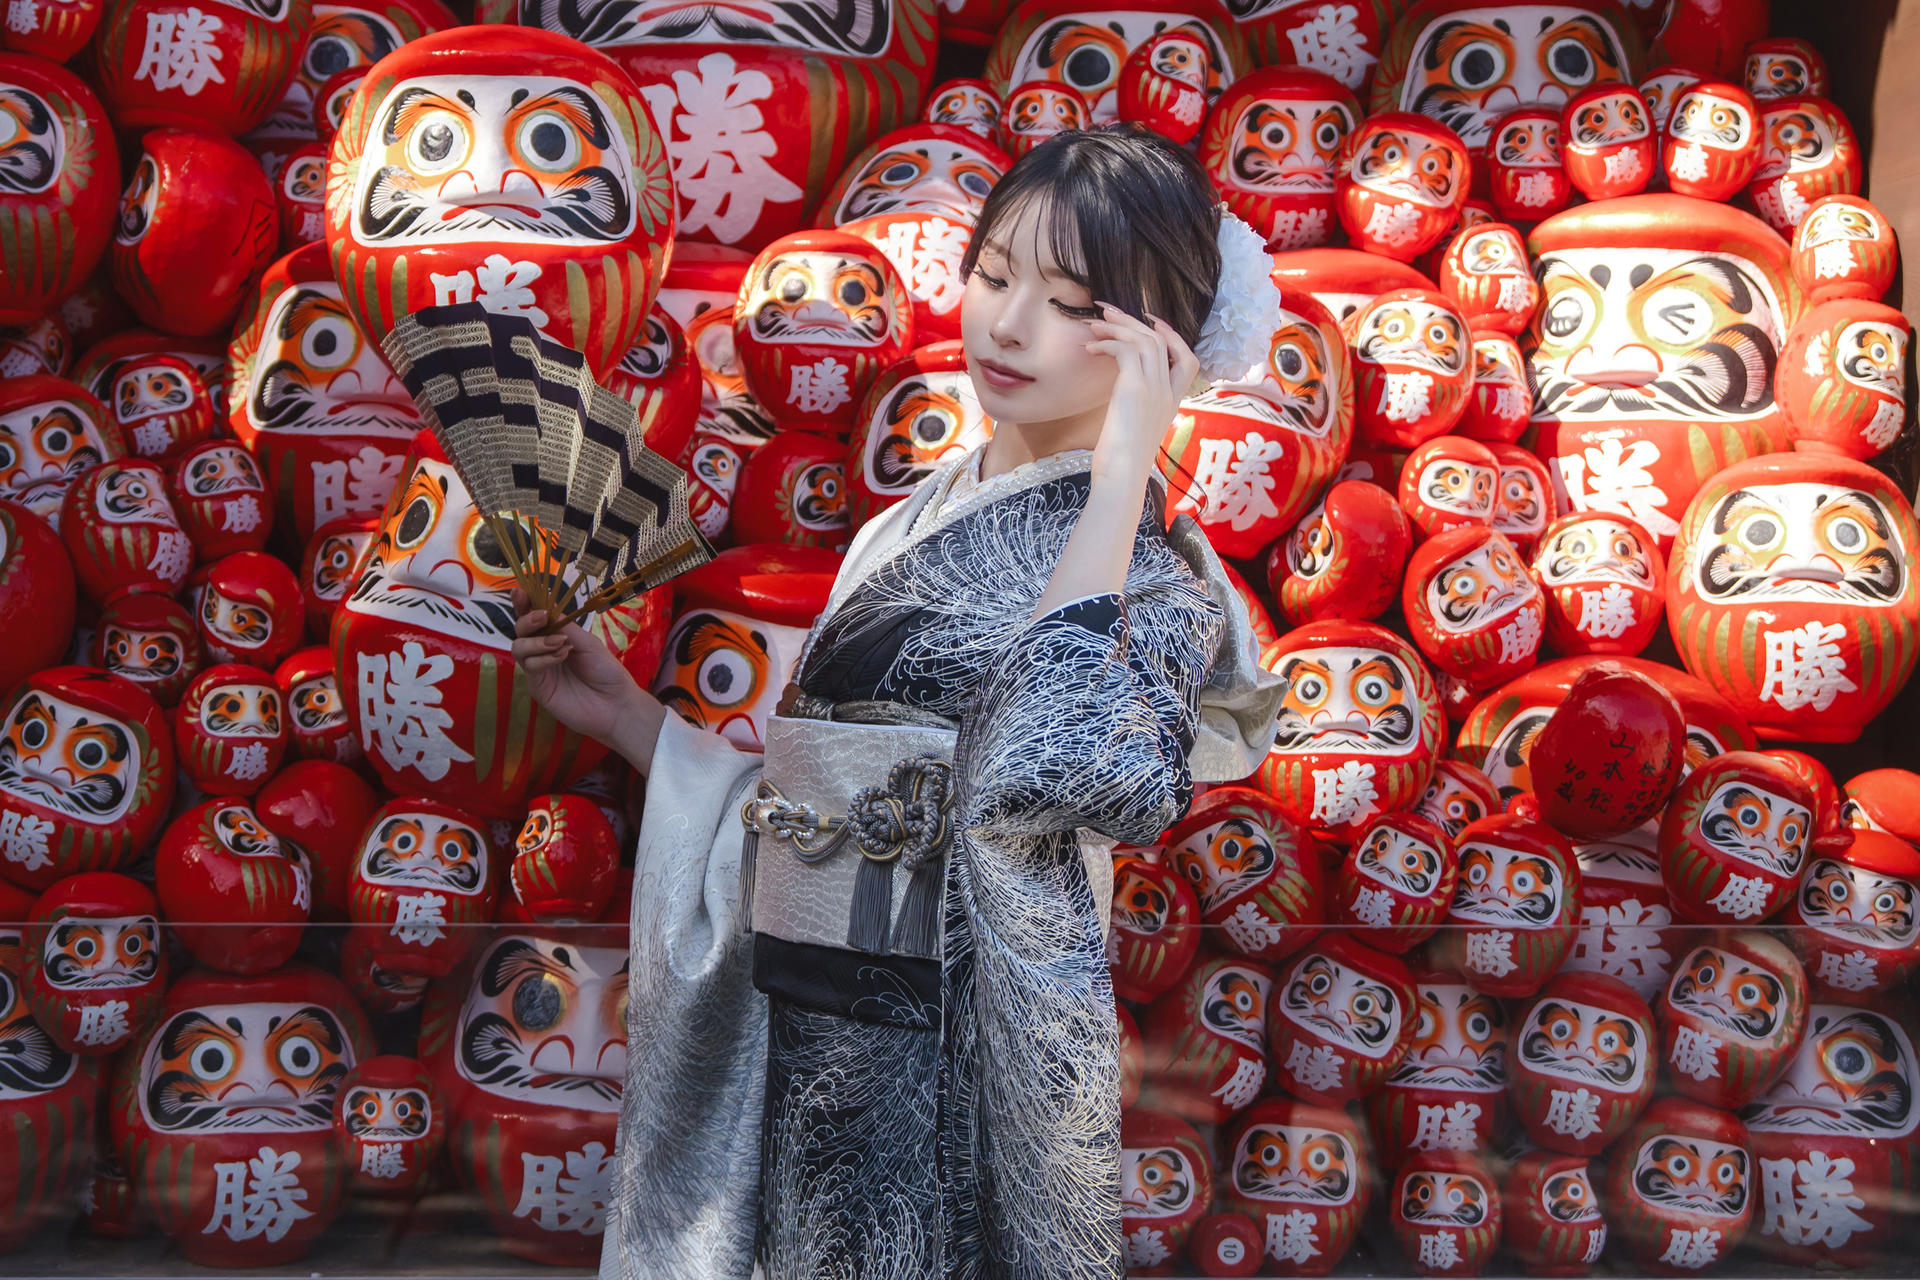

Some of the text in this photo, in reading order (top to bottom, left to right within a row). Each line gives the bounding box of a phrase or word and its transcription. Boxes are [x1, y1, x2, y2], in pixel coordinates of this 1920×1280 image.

[134, 7, 226, 96] 勝
[1287, 4, 1379, 90] 勝
[640, 52, 804, 243] 勝
[1515, 172, 1556, 207] 勝
[1268, 208, 1329, 251] 勝
[1363, 202, 1422, 247] 勝
[875, 217, 968, 315] 勝
[1495, 275, 1538, 313] 勝
[786, 357, 851, 414] 勝
[1376, 371, 1434, 422] 勝
[133, 418, 174, 454] 勝
[1860, 400, 1906, 449] 勝
[1176, 431, 1282, 531] 勝
[221, 494, 262, 533] 勝
[148, 531, 192, 583] 勝
[1498, 607, 1541, 664] 勝
[1577, 583, 1636, 638] 勝
[1760, 621, 1858, 712] 勝
[357, 641, 475, 782] 勝
[225, 742, 268, 780] 勝
[1311, 761, 1380, 826] 勝
[1, 809, 54, 871] 勝
[390, 892, 446, 946] 勝
[1351, 886, 1396, 928] 勝
[1707, 872, 1773, 920] 勝
[1221, 901, 1284, 954] 勝
[1465, 929, 1519, 978] 勝
[1816, 950, 1879, 992] 勝
[74, 1000, 130, 1046] 勝
[1285, 1039, 1345, 1091] 勝
[1670, 1025, 1721, 1081] 勝
[1211, 1057, 1266, 1110] 勝
[1408, 1101, 1482, 1151] 勝
[1542, 1088, 1602, 1139] 勝
[360, 1144, 407, 1178] 勝
[202, 1147, 314, 1242] 勝
[512, 1142, 615, 1235] 勝
[1759, 1150, 1875, 1250] 勝
[1223, 1244, 1237, 1258] 10
[1265, 1209, 1321, 1264] 勝
[1418, 1230, 1464, 1269] 勝
[1659, 1226, 1721, 1269] 勝
